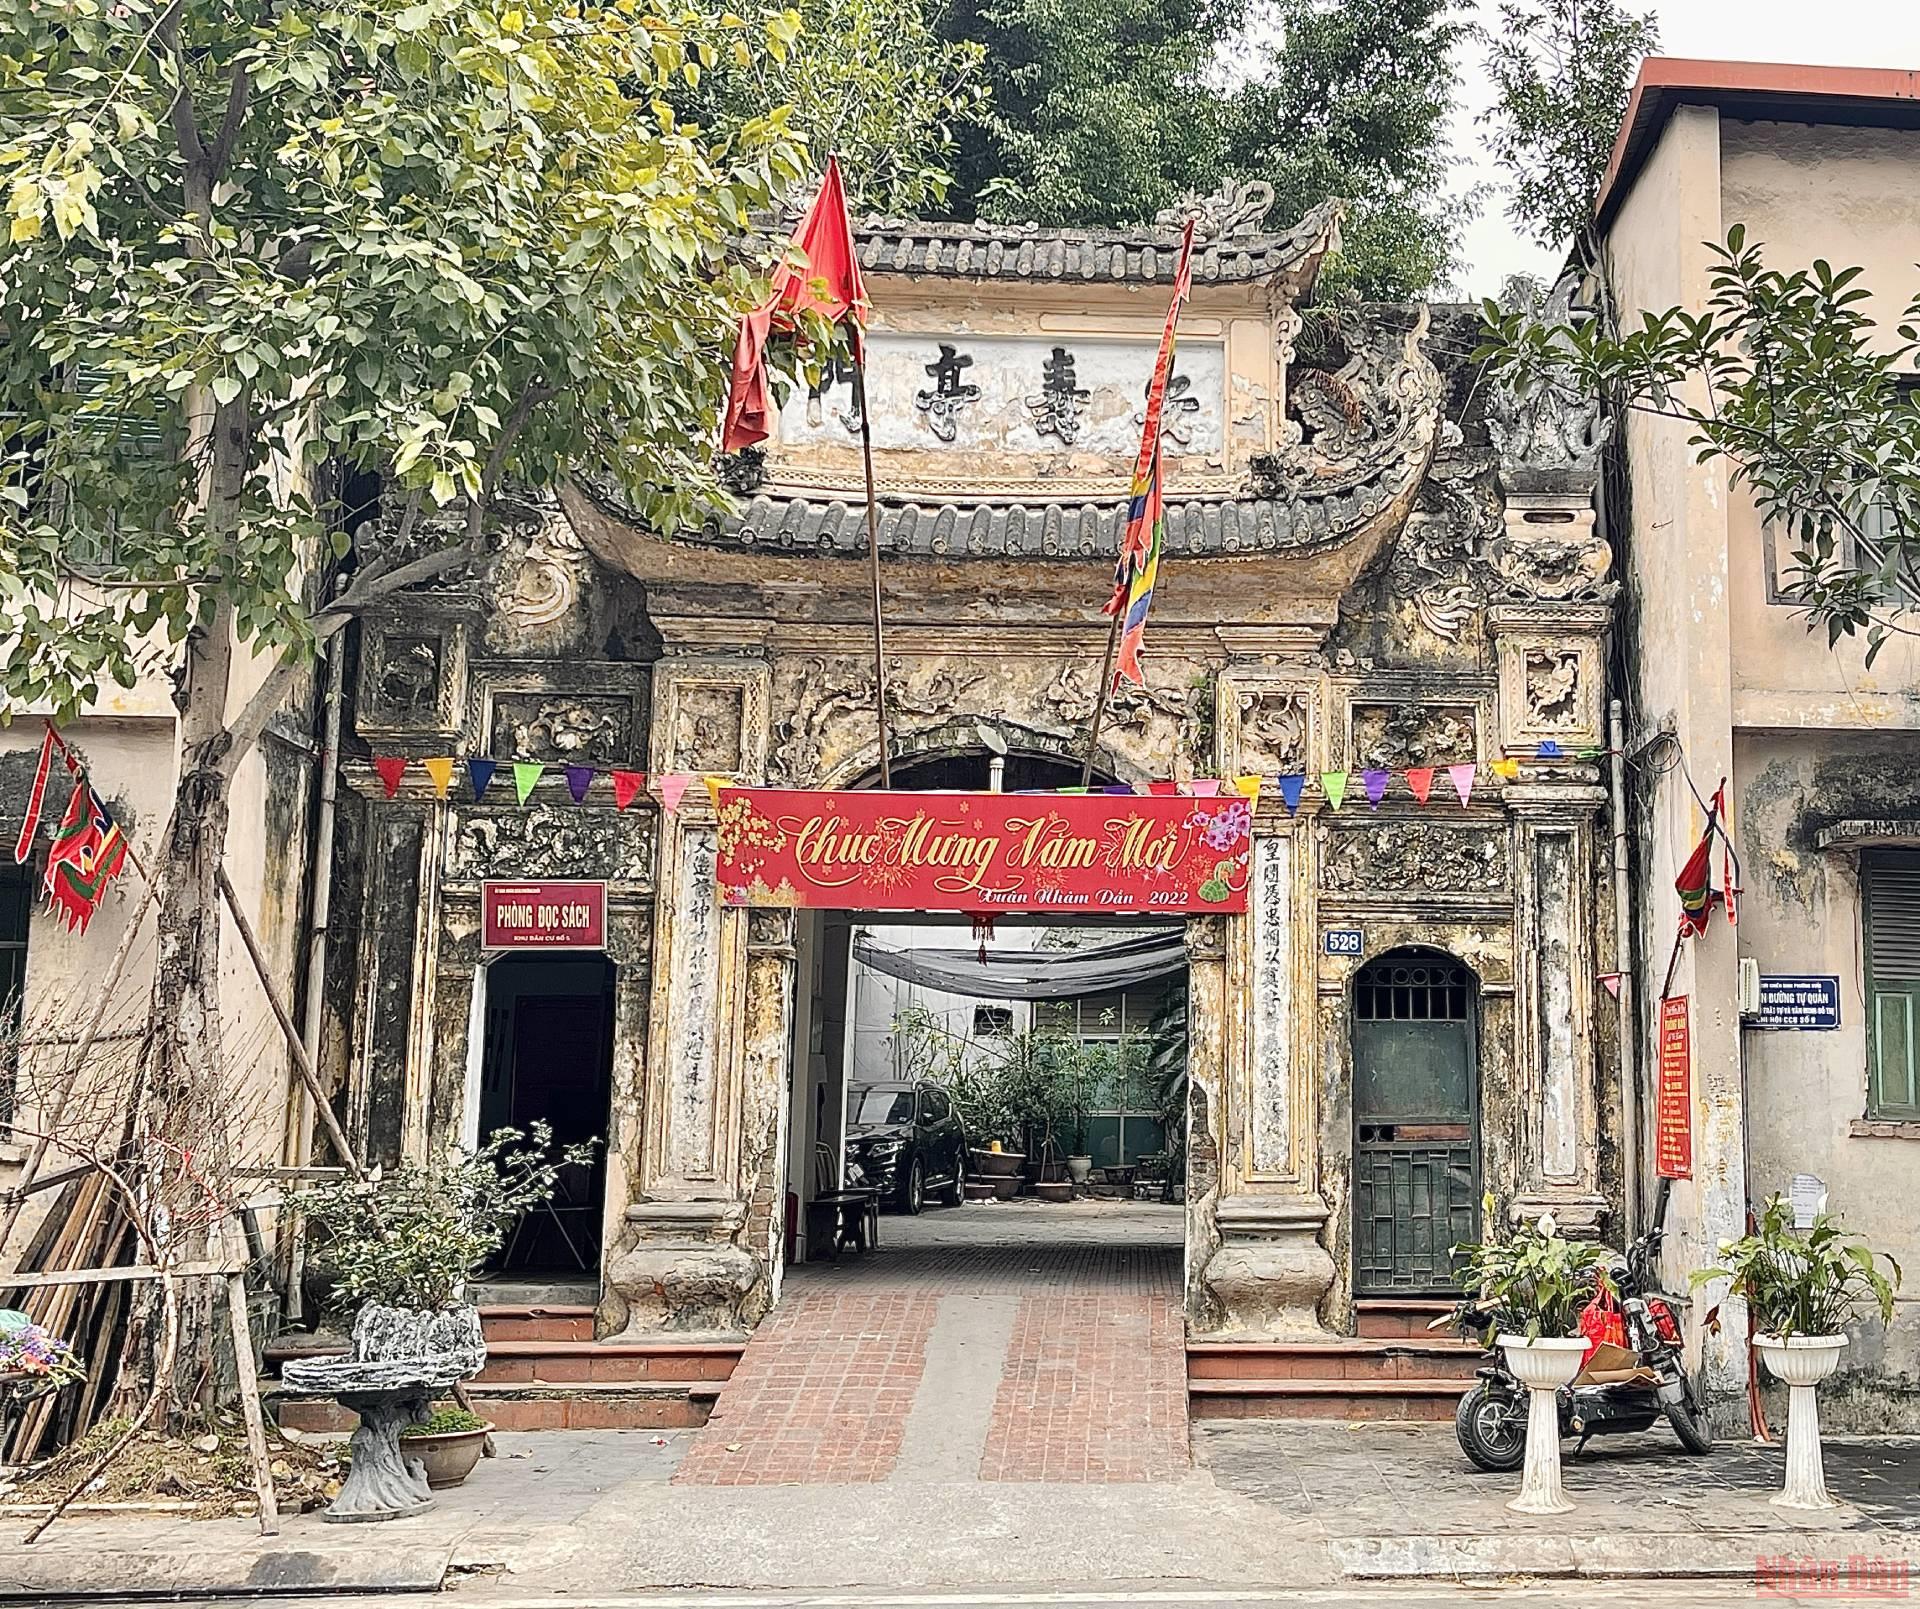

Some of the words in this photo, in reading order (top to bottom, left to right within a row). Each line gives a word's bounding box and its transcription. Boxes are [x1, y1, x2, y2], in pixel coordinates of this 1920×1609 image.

[777, 815, 880, 886] Chúc
[1004, 816, 1101, 869] Năm
[978, 888, 1028, 904] Xuân
[1148, 890, 1189, 905] 2022
[497, 901, 533, 928] PHÒNG
[537, 905, 559, 931] ĐỌC
[562, 901, 590, 928] SÁCH
[1329, 933, 1359, 950] 528
[1768, 990, 1795, 1003] ĐƯỜNG
[1796, 992, 1806, 1006] TỰ
[1808, 989, 1829, 1004] QUẢN
